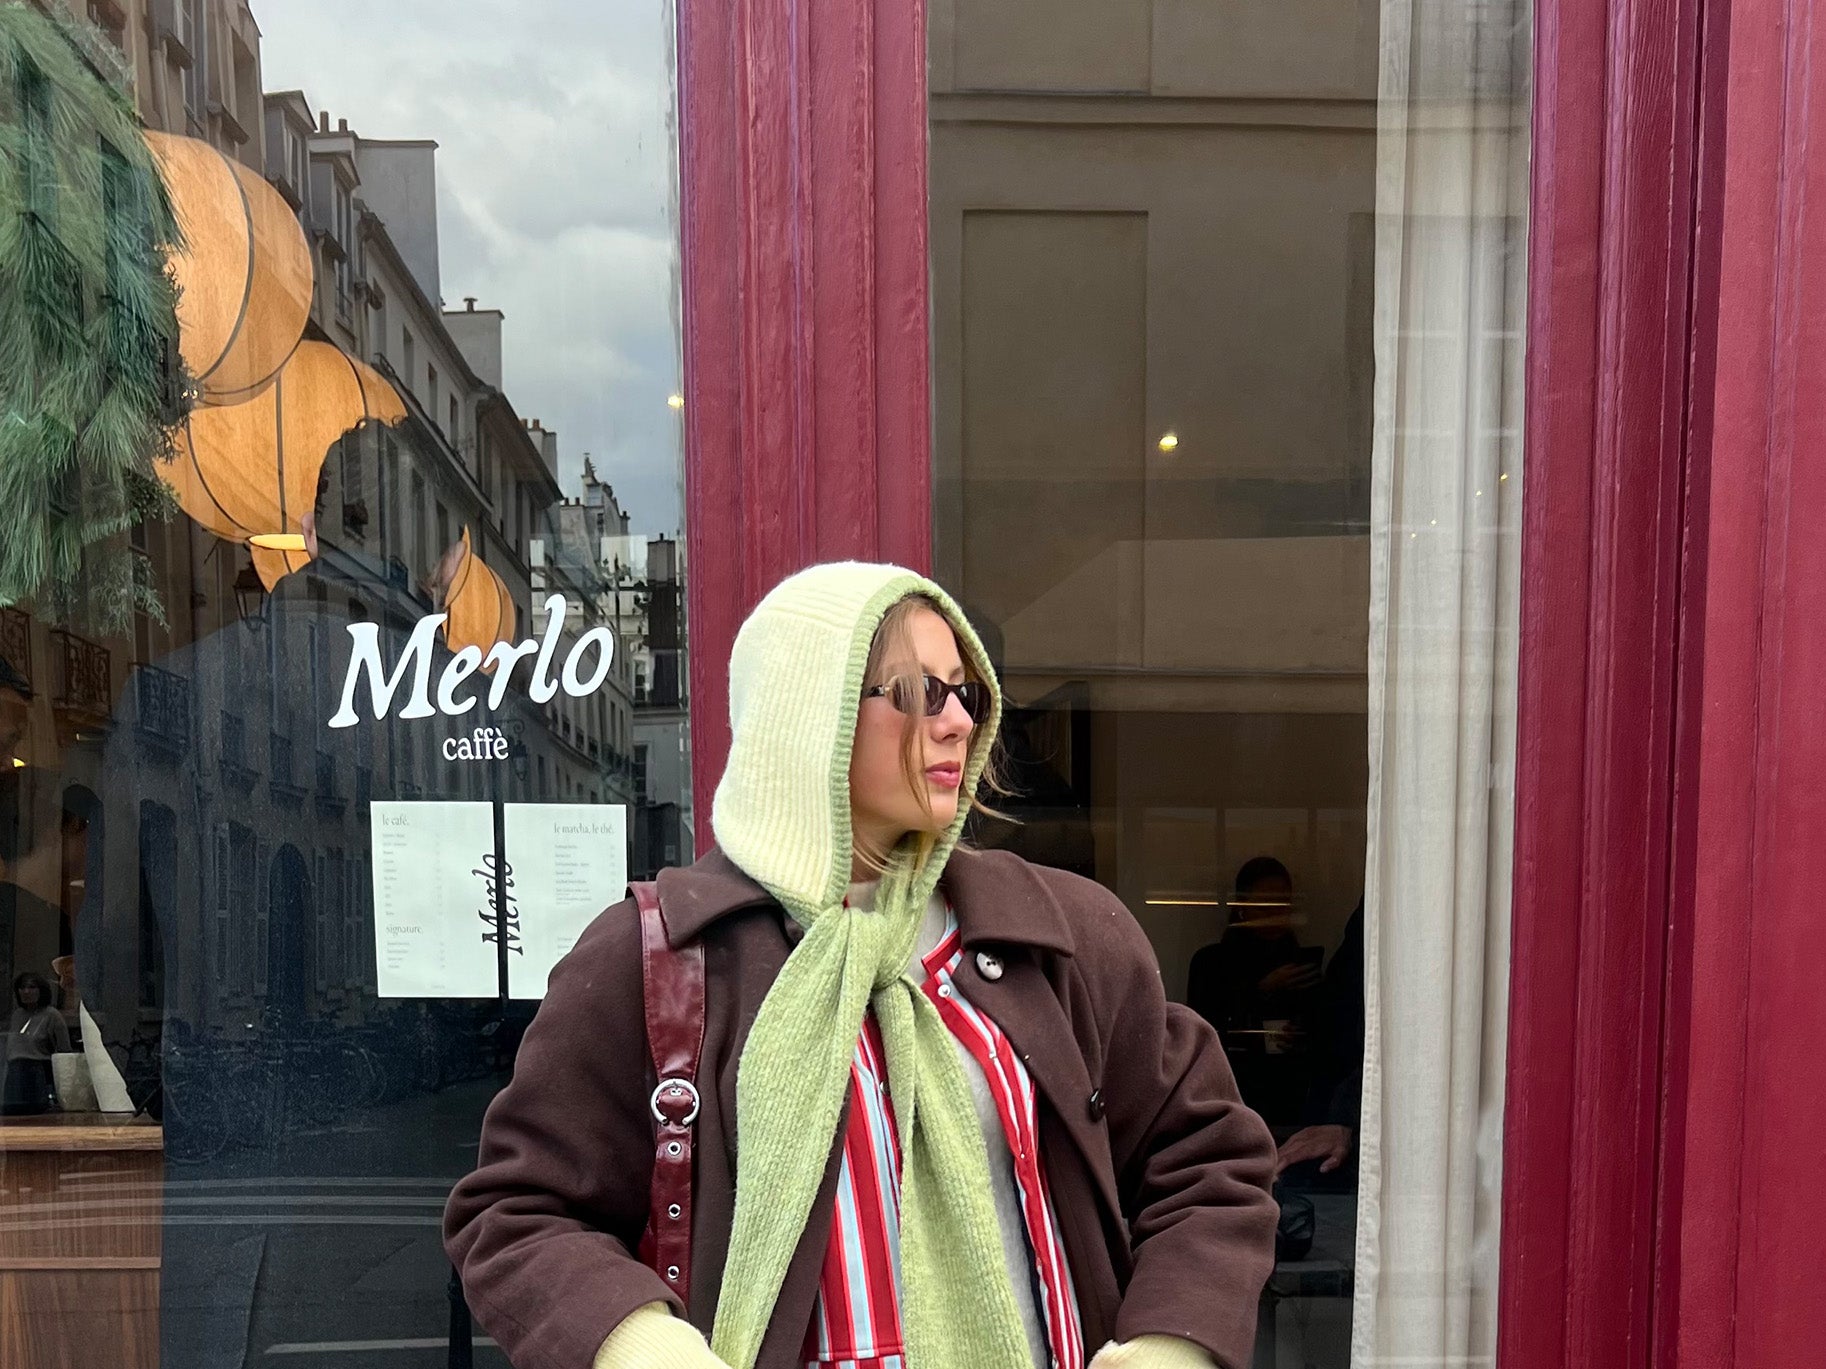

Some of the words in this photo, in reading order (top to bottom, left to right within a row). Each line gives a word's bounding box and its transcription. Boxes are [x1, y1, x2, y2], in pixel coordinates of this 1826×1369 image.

[328, 594, 614, 728] Merlo
[442, 728, 509, 761] caffè
[382, 814, 390, 826] le
[554, 822, 561, 834] le
[592, 822, 600, 834] le
